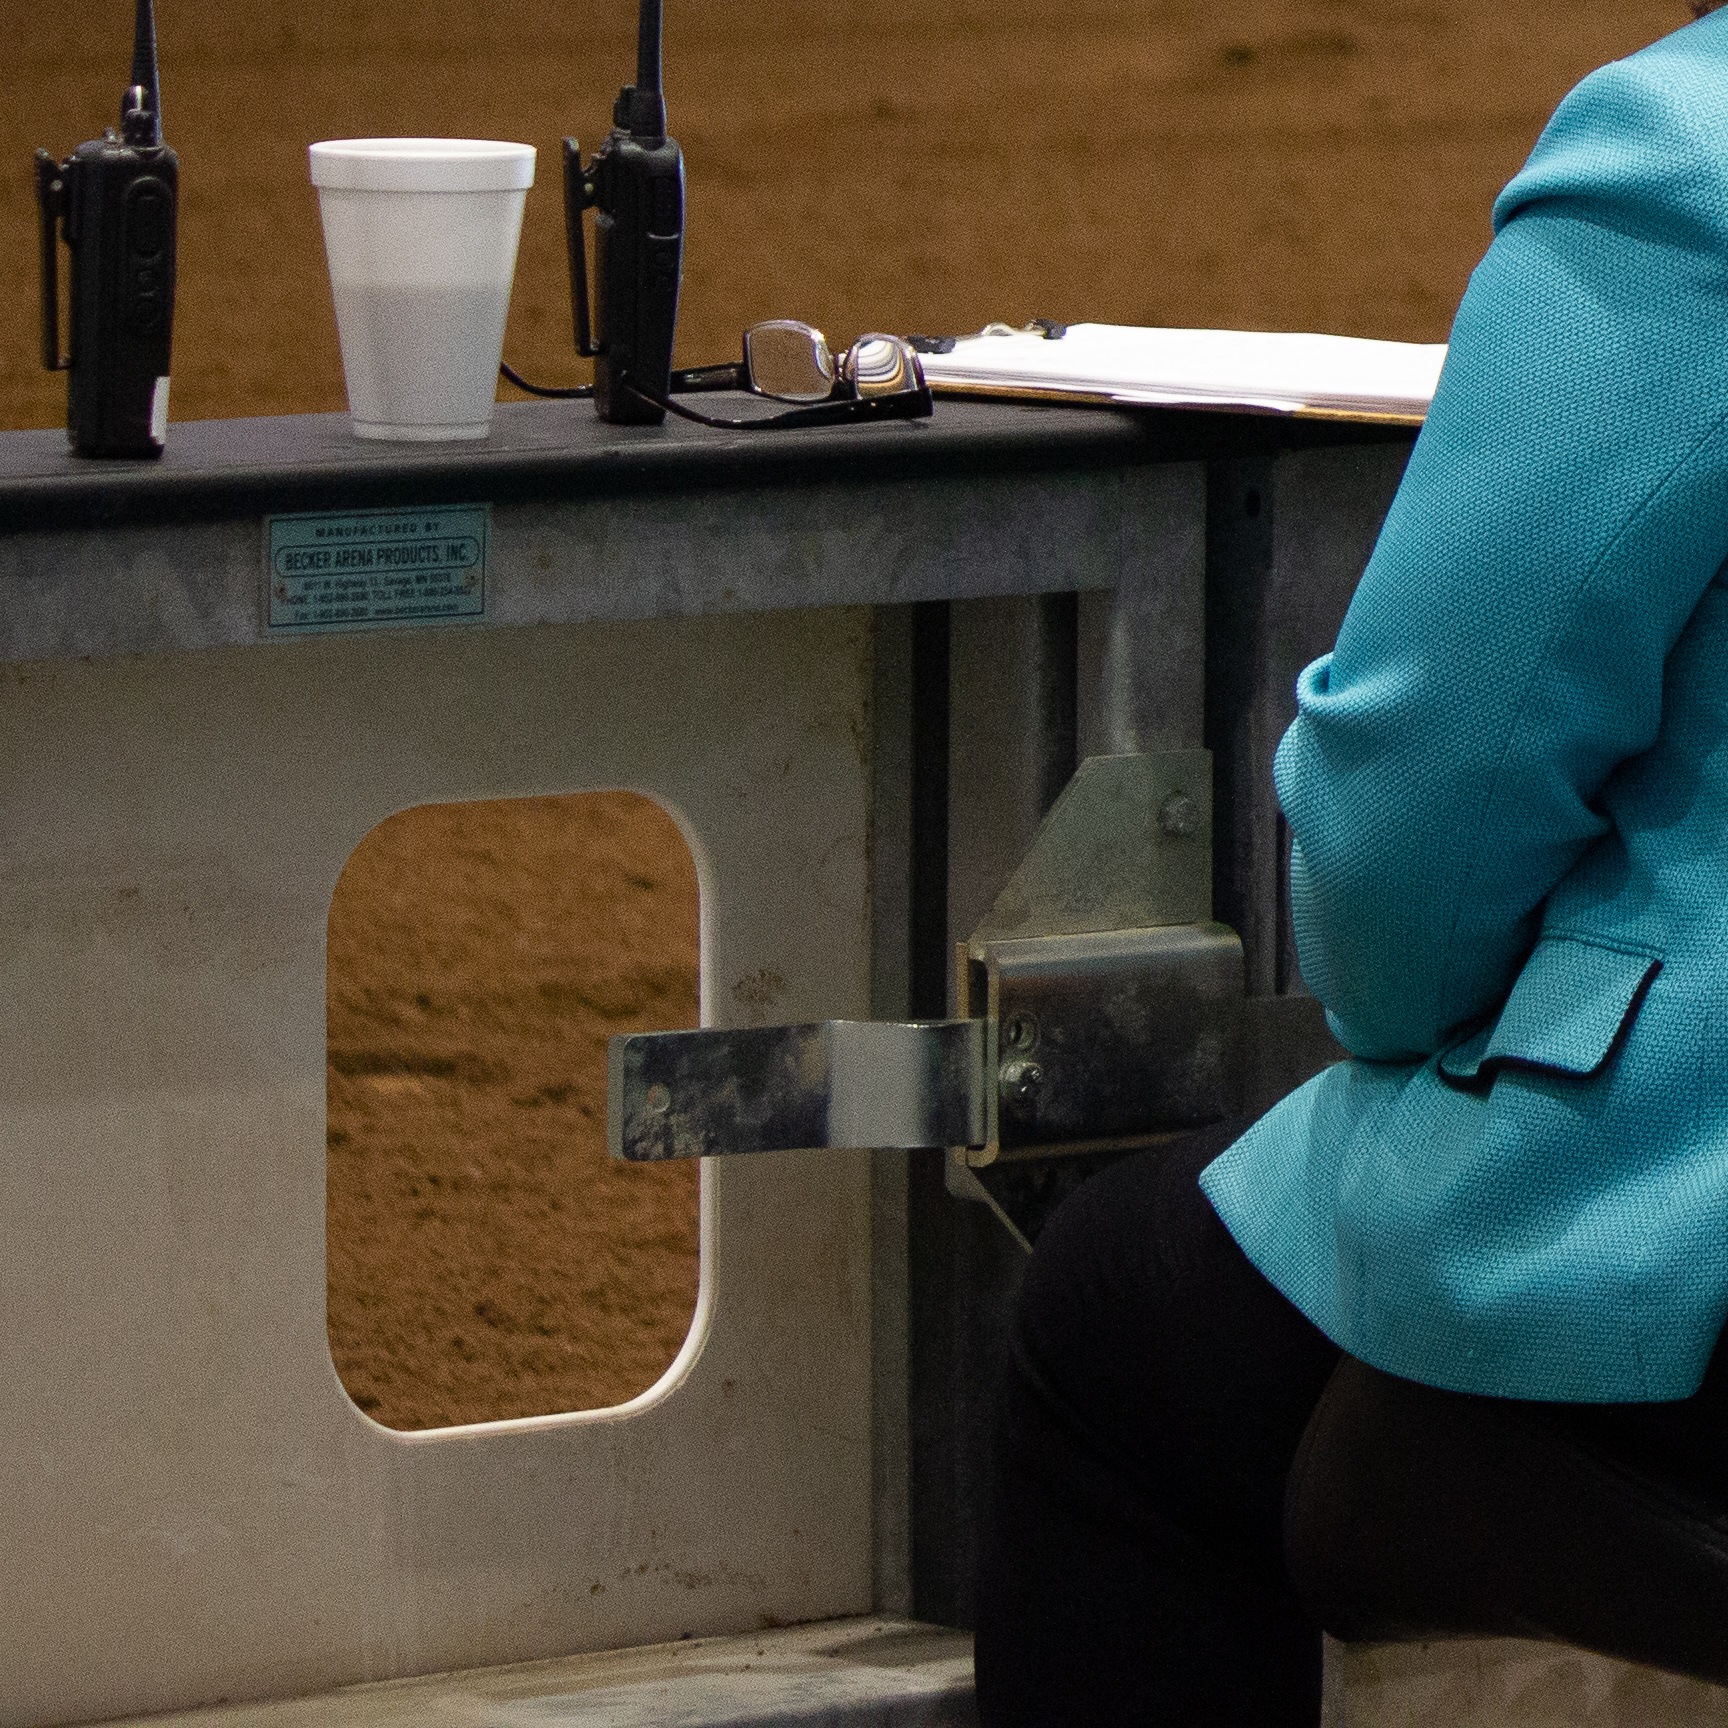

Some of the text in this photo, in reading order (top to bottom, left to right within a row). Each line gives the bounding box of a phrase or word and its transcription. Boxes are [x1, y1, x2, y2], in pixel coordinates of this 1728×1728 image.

[315, 521, 440, 537] MANUFACTURED BY
[285, 551, 331, 571] BECKER
[335, 548, 373, 568] ARENA
